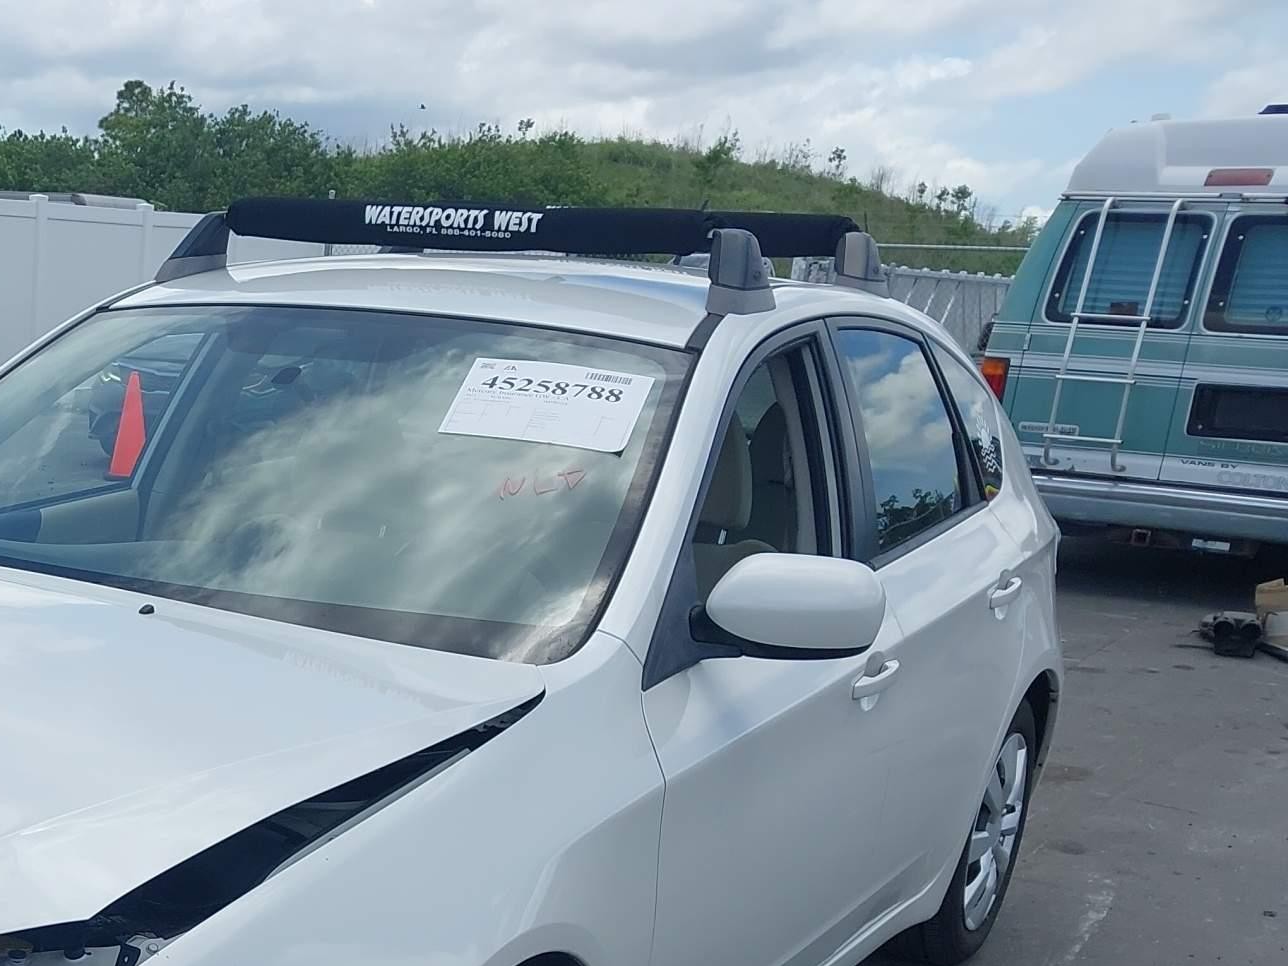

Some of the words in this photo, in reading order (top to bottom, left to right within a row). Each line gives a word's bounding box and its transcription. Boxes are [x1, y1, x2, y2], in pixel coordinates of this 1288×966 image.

[365, 205, 489, 229] WATERSPORTS
[494, 211, 544, 232] WEST
[386, 226, 423, 234] LARGO,
[481, 376, 623, 402] 45258788
[1179, 459, 1215, 467] VANS
